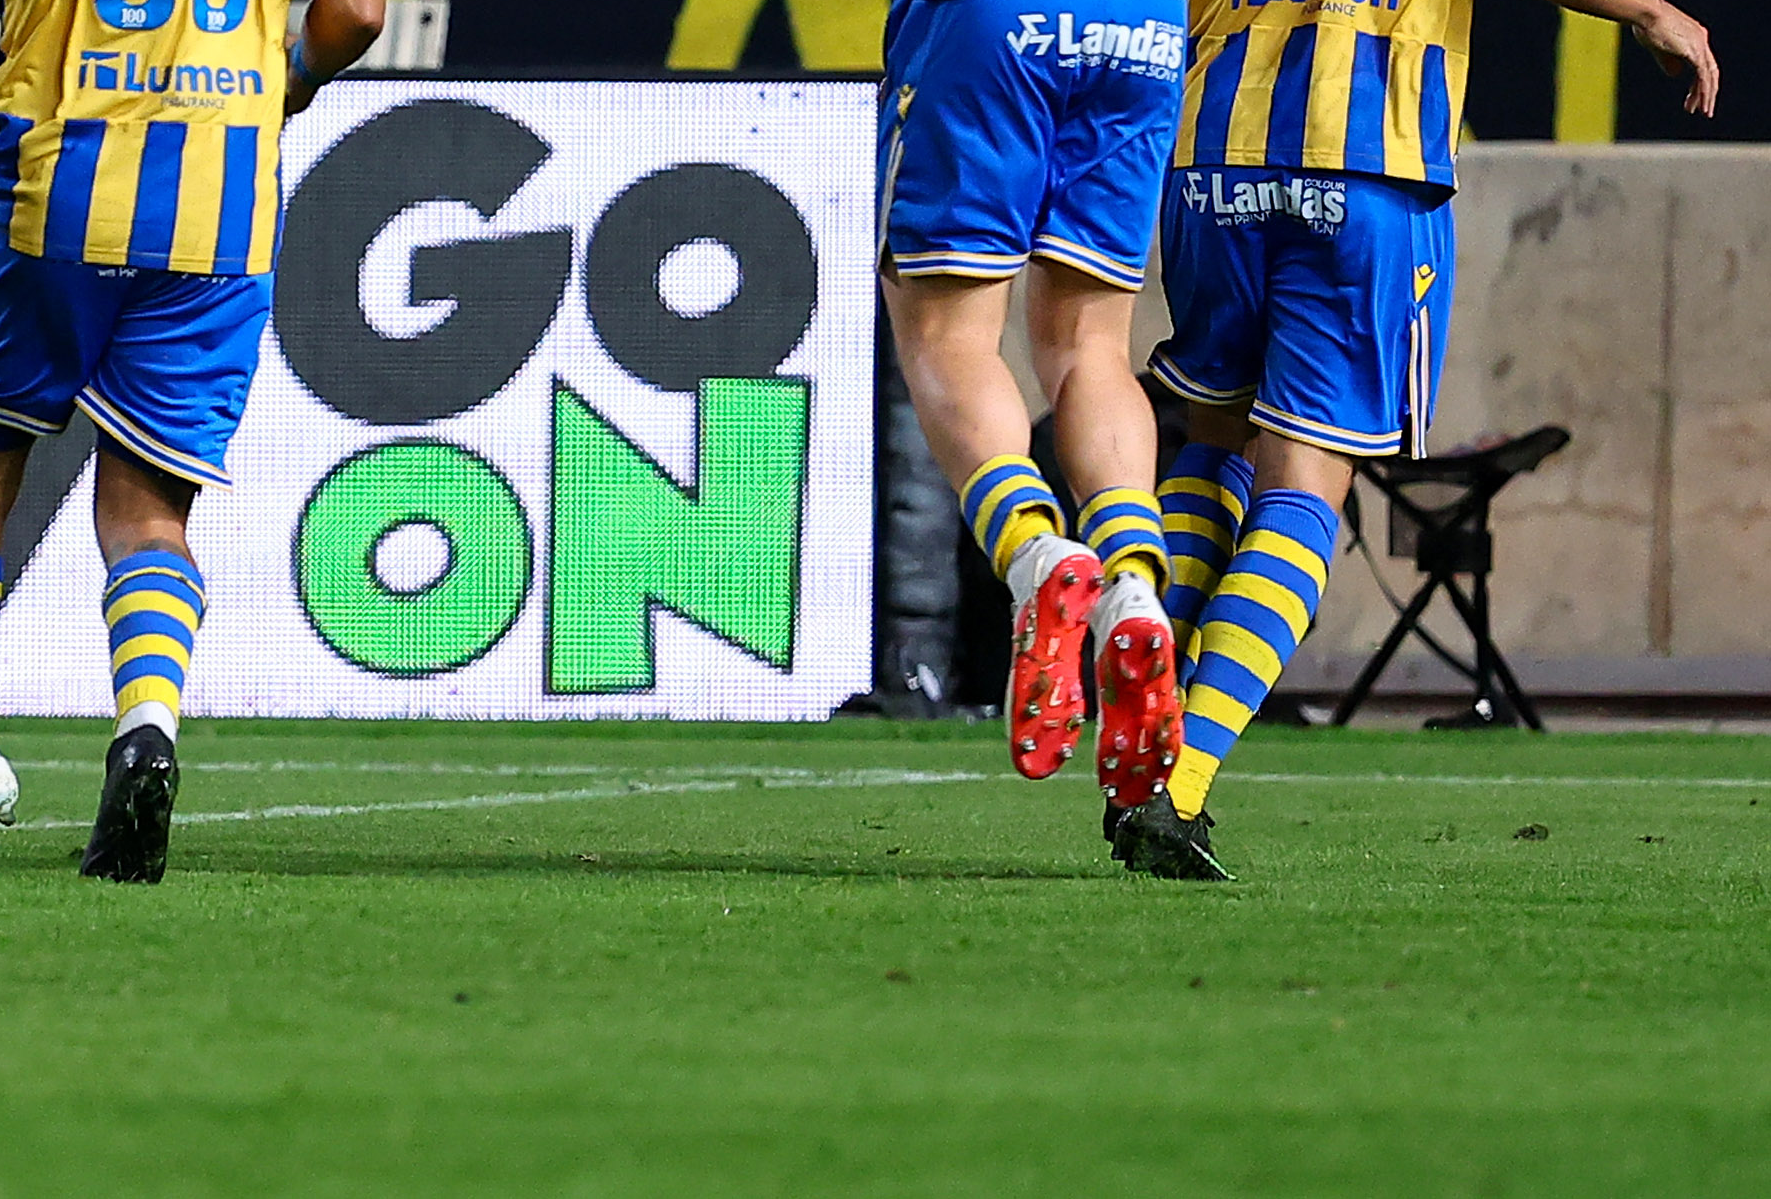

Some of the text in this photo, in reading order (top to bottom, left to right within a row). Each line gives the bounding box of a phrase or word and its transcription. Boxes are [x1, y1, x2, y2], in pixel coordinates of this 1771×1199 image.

[121, 8, 147, 24] 100
[1057, 12, 1183, 70] Landas
[123, 52, 264, 96] Lumen
[1211, 172, 1346, 224] Landas
[1304, 178, 1346, 191] COLOUR
[271, 97, 819, 426] GO
[295, 373, 813, 695] ON
